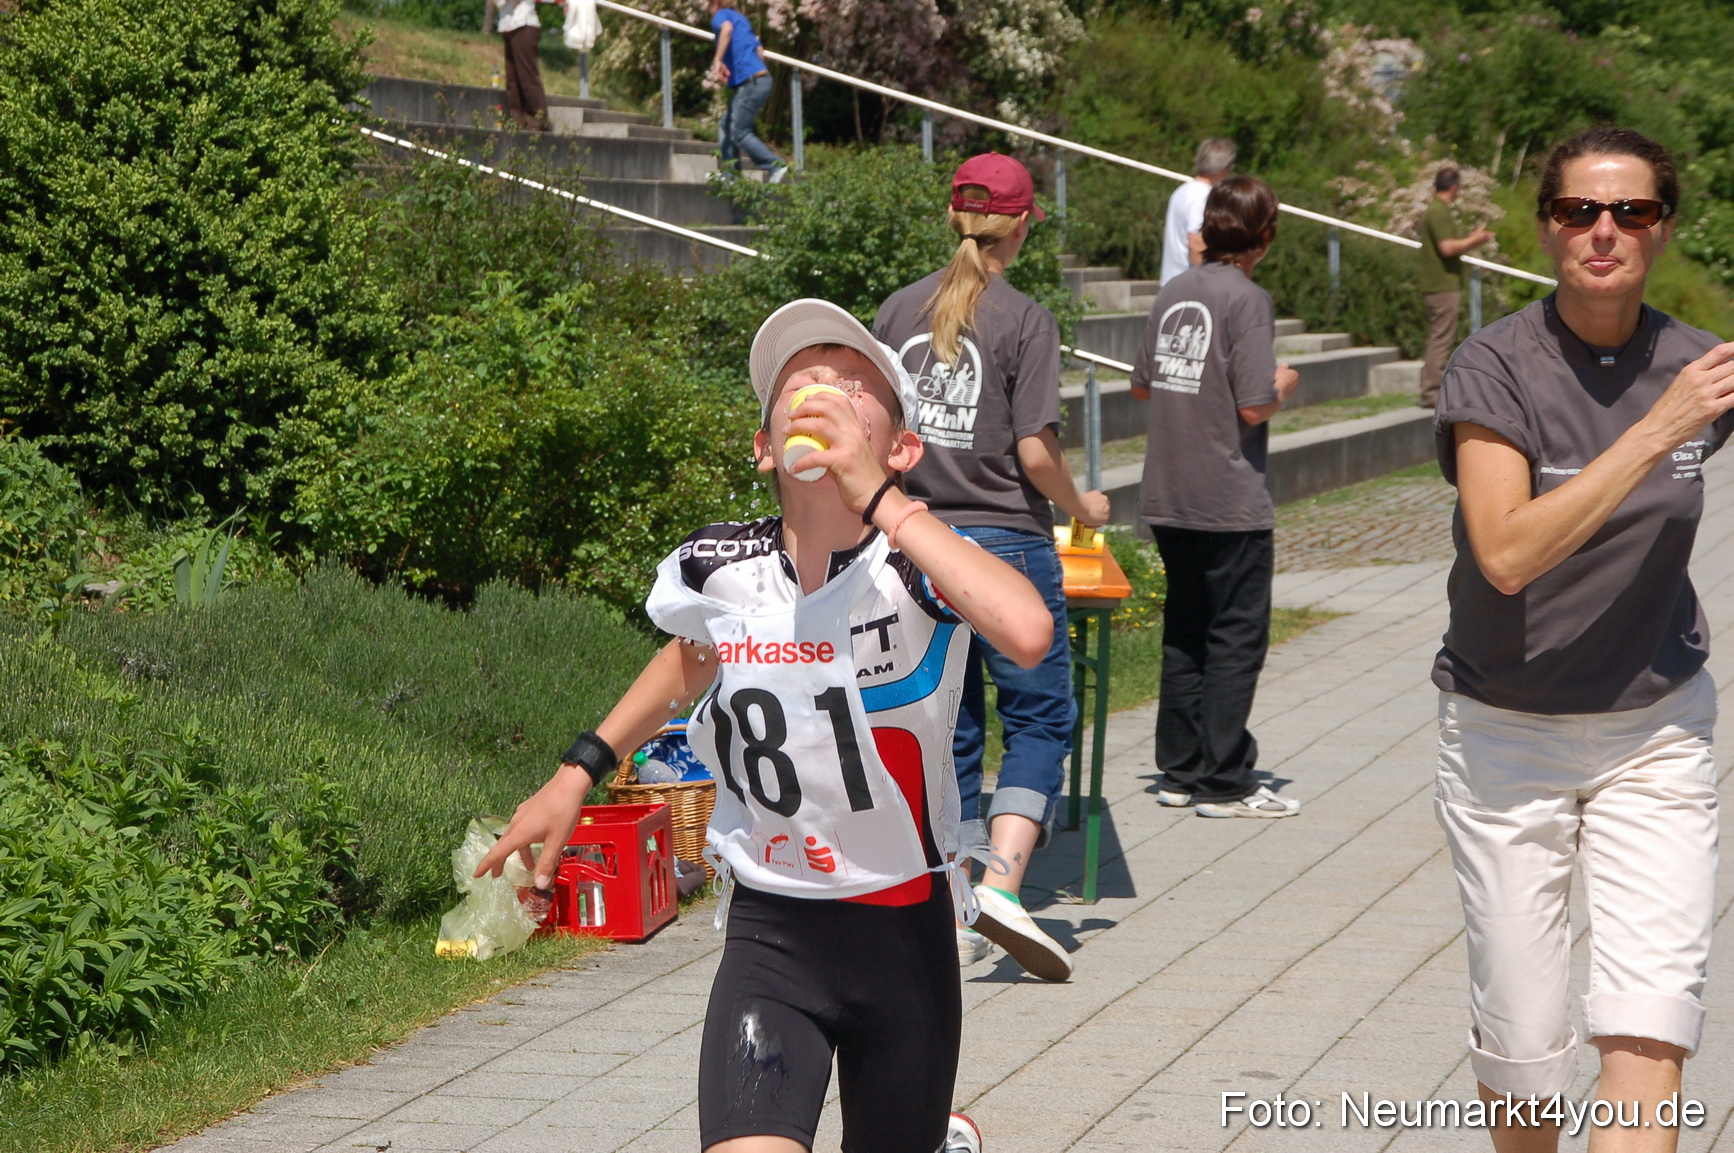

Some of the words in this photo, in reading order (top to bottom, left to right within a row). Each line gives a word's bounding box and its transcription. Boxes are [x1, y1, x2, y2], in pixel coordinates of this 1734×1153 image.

[918, 400, 978, 431] WinN
[679, 536, 772, 562] SCOTT
[713, 635, 834, 664] arkasse
